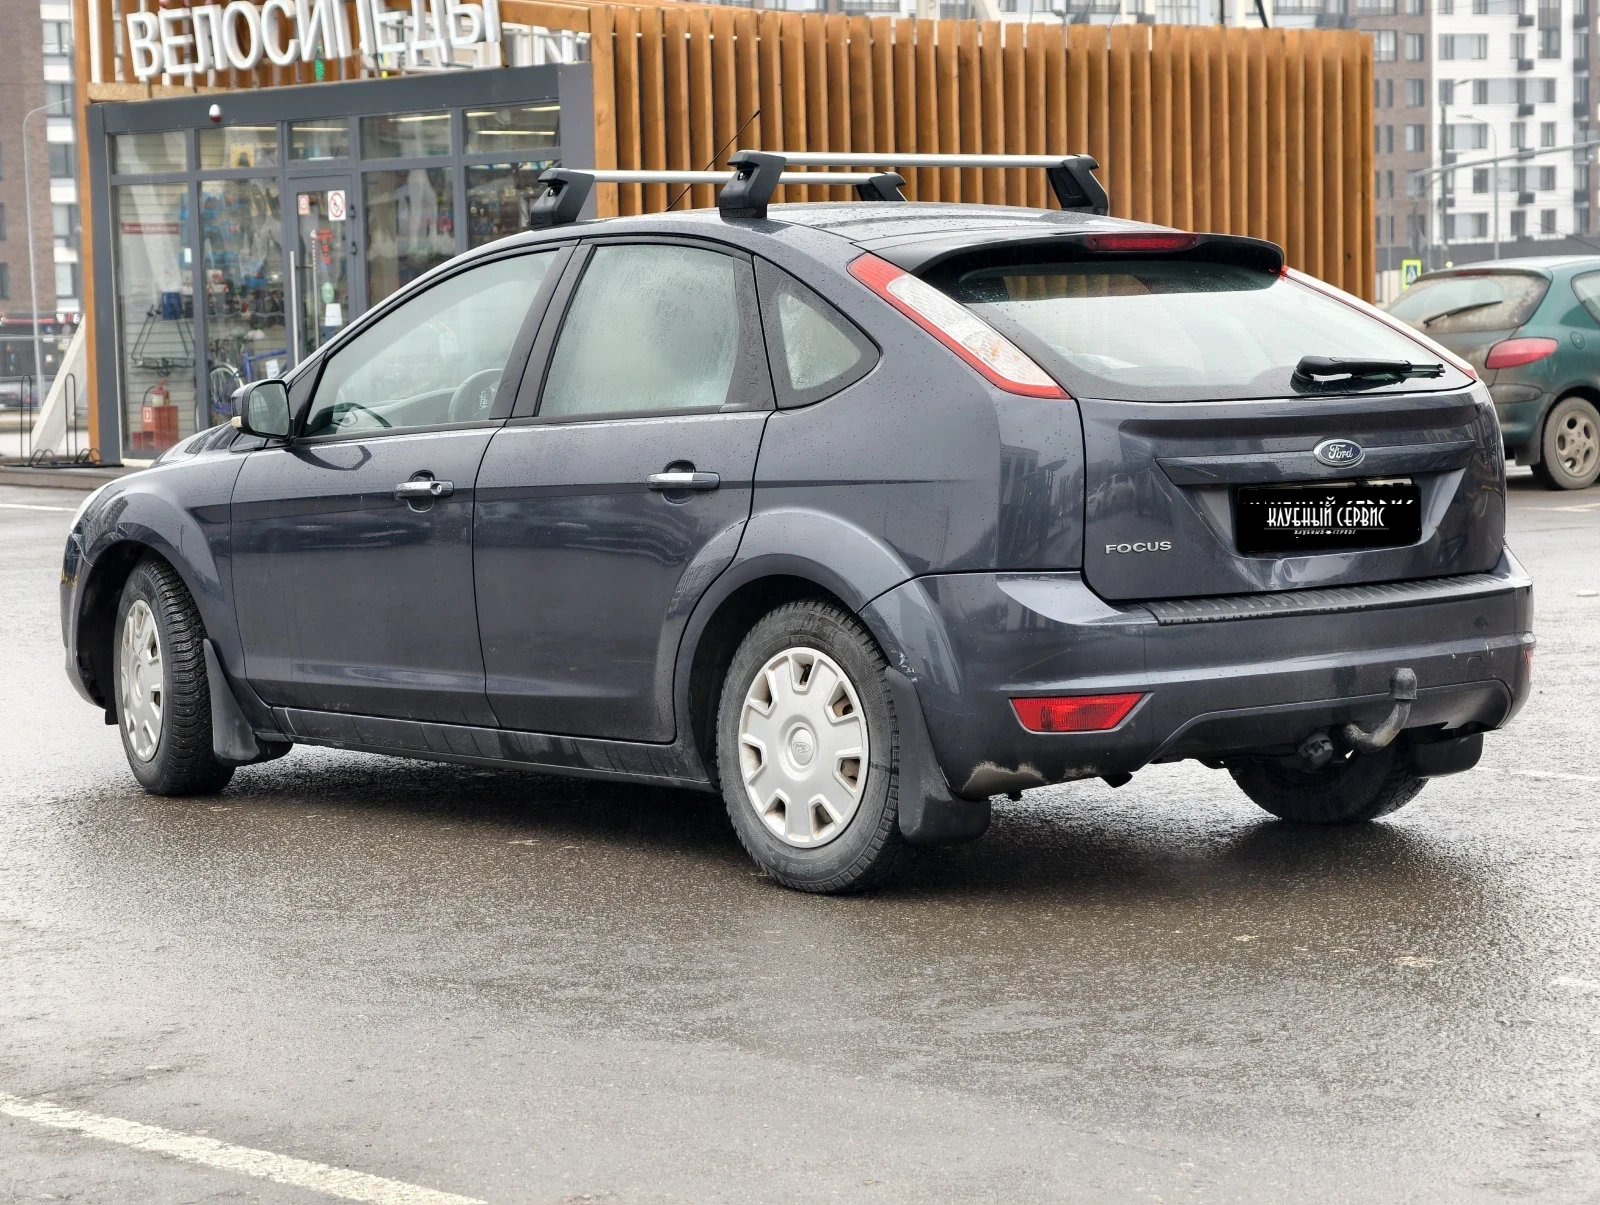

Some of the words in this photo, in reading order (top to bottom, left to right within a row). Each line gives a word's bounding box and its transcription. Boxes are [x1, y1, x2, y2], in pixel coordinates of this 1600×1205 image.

[126, 0, 501, 77] ВЕЛОСИПЕДЫ
[1328, 444, 1354, 460] Ford
[1105, 541, 1172, 554] FOCUS
